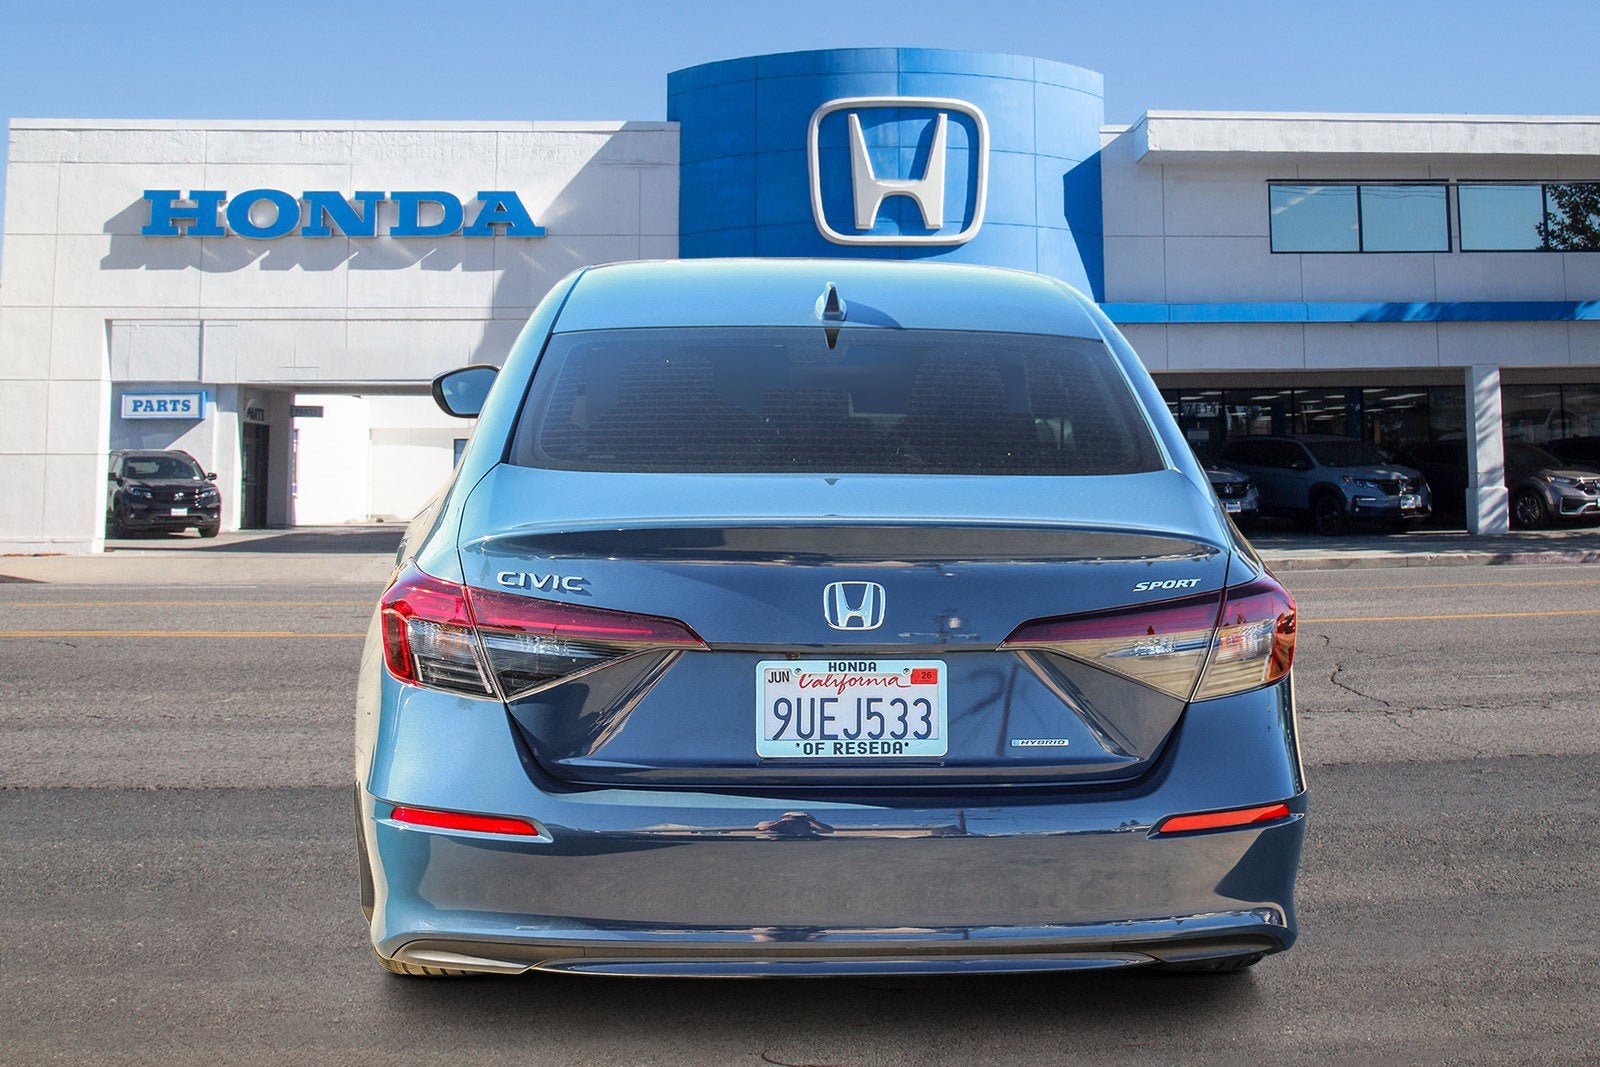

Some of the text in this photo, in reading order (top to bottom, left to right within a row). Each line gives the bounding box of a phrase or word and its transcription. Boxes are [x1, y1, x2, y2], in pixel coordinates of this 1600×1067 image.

[141, 189, 547, 239] HONDA
[132, 400, 191, 412] PARTS
[246, 407, 265, 421] PARTS
[497, 571, 584, 591] CIVIC
[1132, 578, 1202, 592] SPORT
[828, 661, 877, 672] HONDA
[768, 670, 790, 684] JUN
[921, 671, 932, 680] 26
[799, 673, 912, 695] California
[772, 697, 932, 740] 9UEJ533
[802, 742, 903, 755] OF RESEDA
